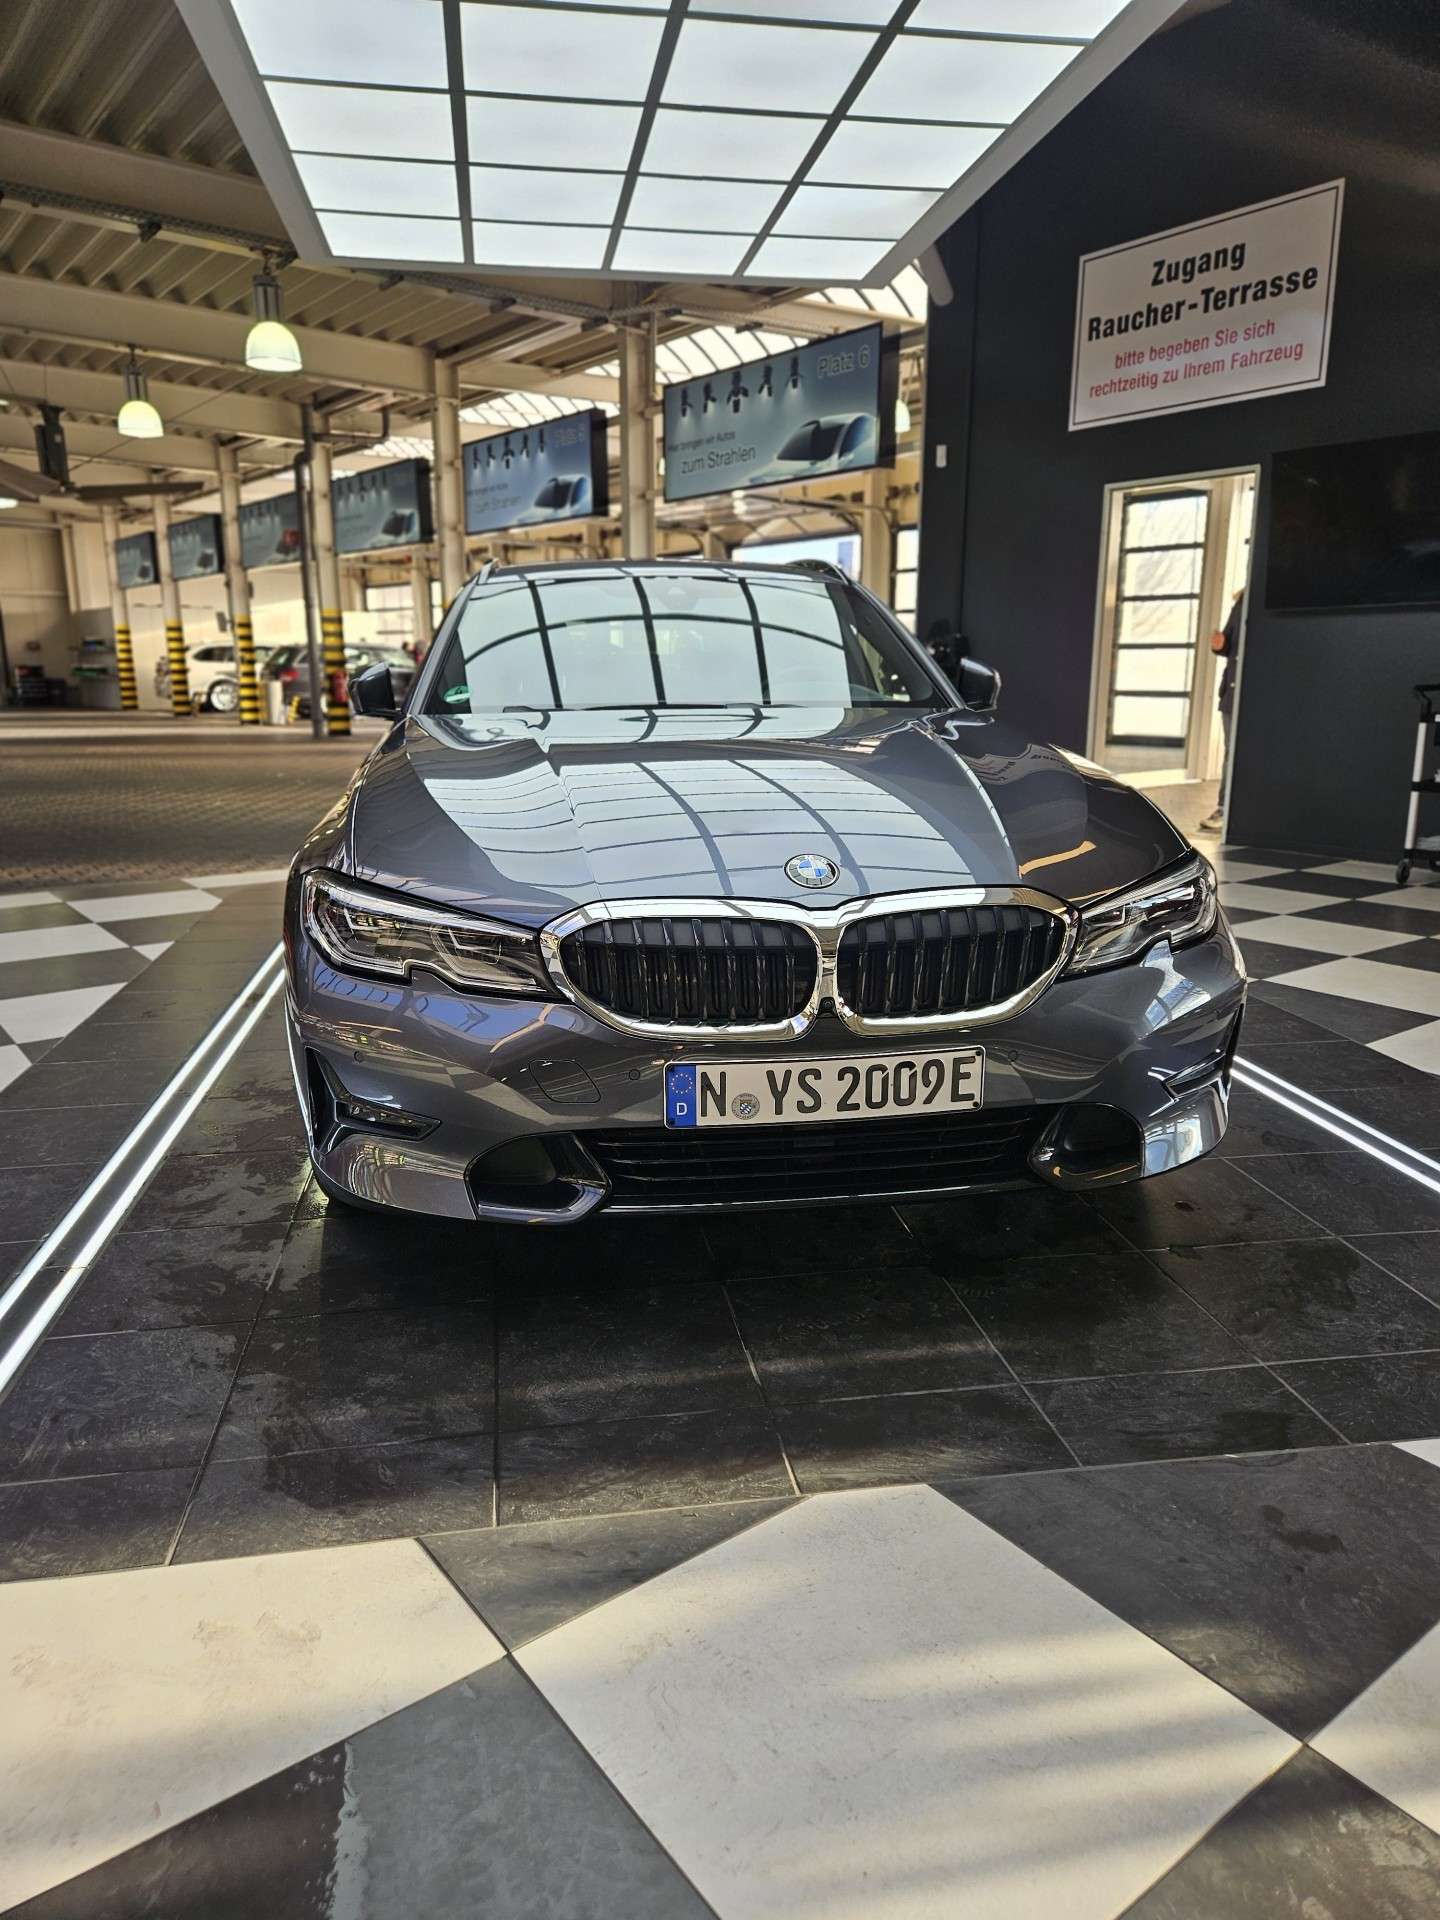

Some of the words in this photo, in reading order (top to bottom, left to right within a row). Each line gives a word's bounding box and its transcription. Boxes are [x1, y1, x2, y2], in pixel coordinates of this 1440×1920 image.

[1151, 242, 1246, 286] Zugang
[1087, 267, 1318, 341] Raucher-Terrasse
[817, 350, 855, 379] Platz
[1115, 350, 1145, 369] bitte
[1150, 334, 1209, 363] begeben
[1215, 328, 1238, 348] Sie
[1243, 319, 1275, 341] sich
[1089, 371, 1158, 398] rechtzeitig
[1162, 370, 1179, 384] zu
[1184, 357, 1225, 379] Ihrem
[1231, 342, 1304, 371] Fahrzeug
[681, 456, 705, 475] zum
[707, 445, 757, 469] Strahlen
[676, 1103, 687, 1116] D
[700, 1071, 727, 1117] N
[765, 1068, 822, 1116] YS
[836, 1055, 977, 1112] 2009E
